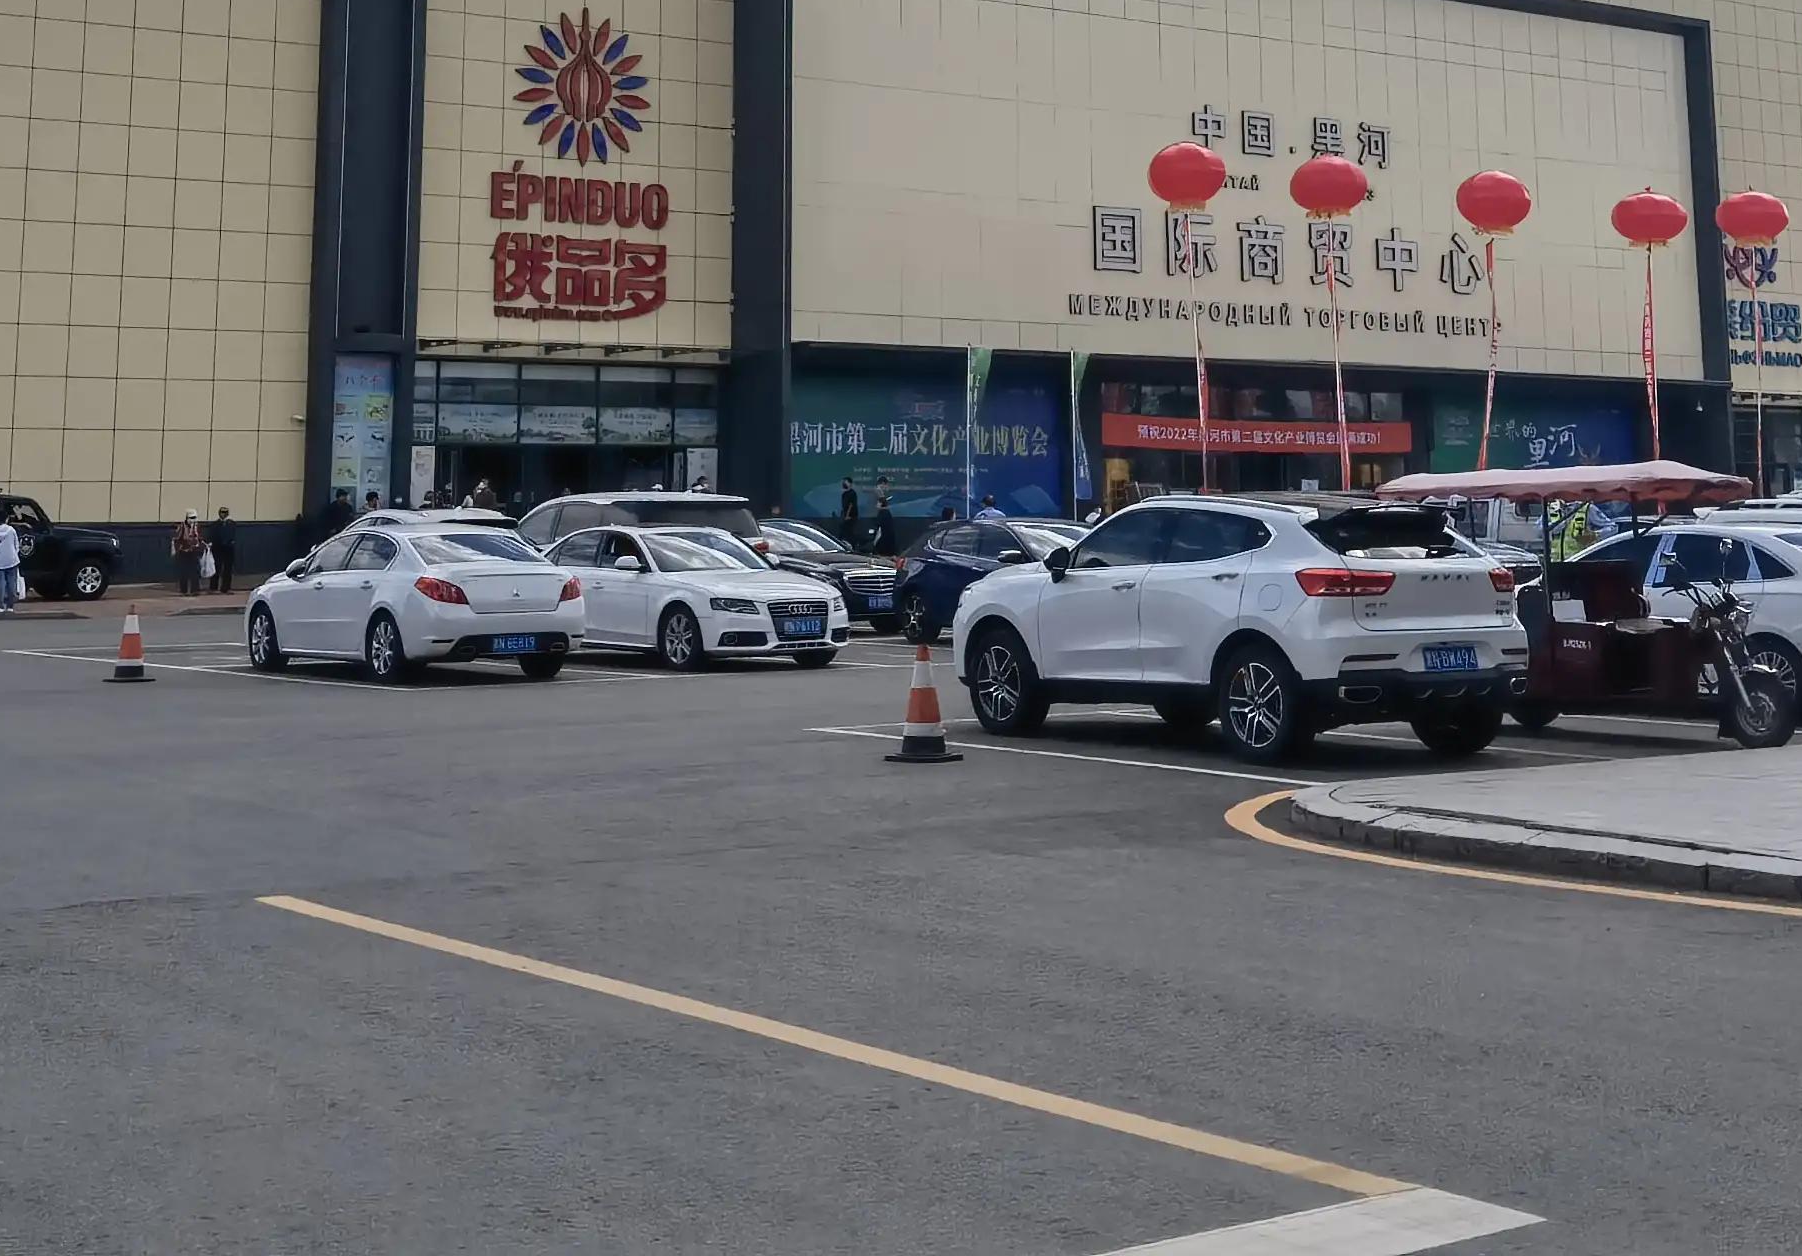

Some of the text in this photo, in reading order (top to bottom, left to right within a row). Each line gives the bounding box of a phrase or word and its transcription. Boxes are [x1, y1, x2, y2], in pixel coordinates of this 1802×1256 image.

[491, 231, 668, 321] 俄品多
[1093, 205, 1484, 295] 国际商贸中心
[1068, 293, 1292, 327] МЕЖДУНАРОДНЫЙ
[1304, 305, 1425, 334] ТОРГОВЫЙ
